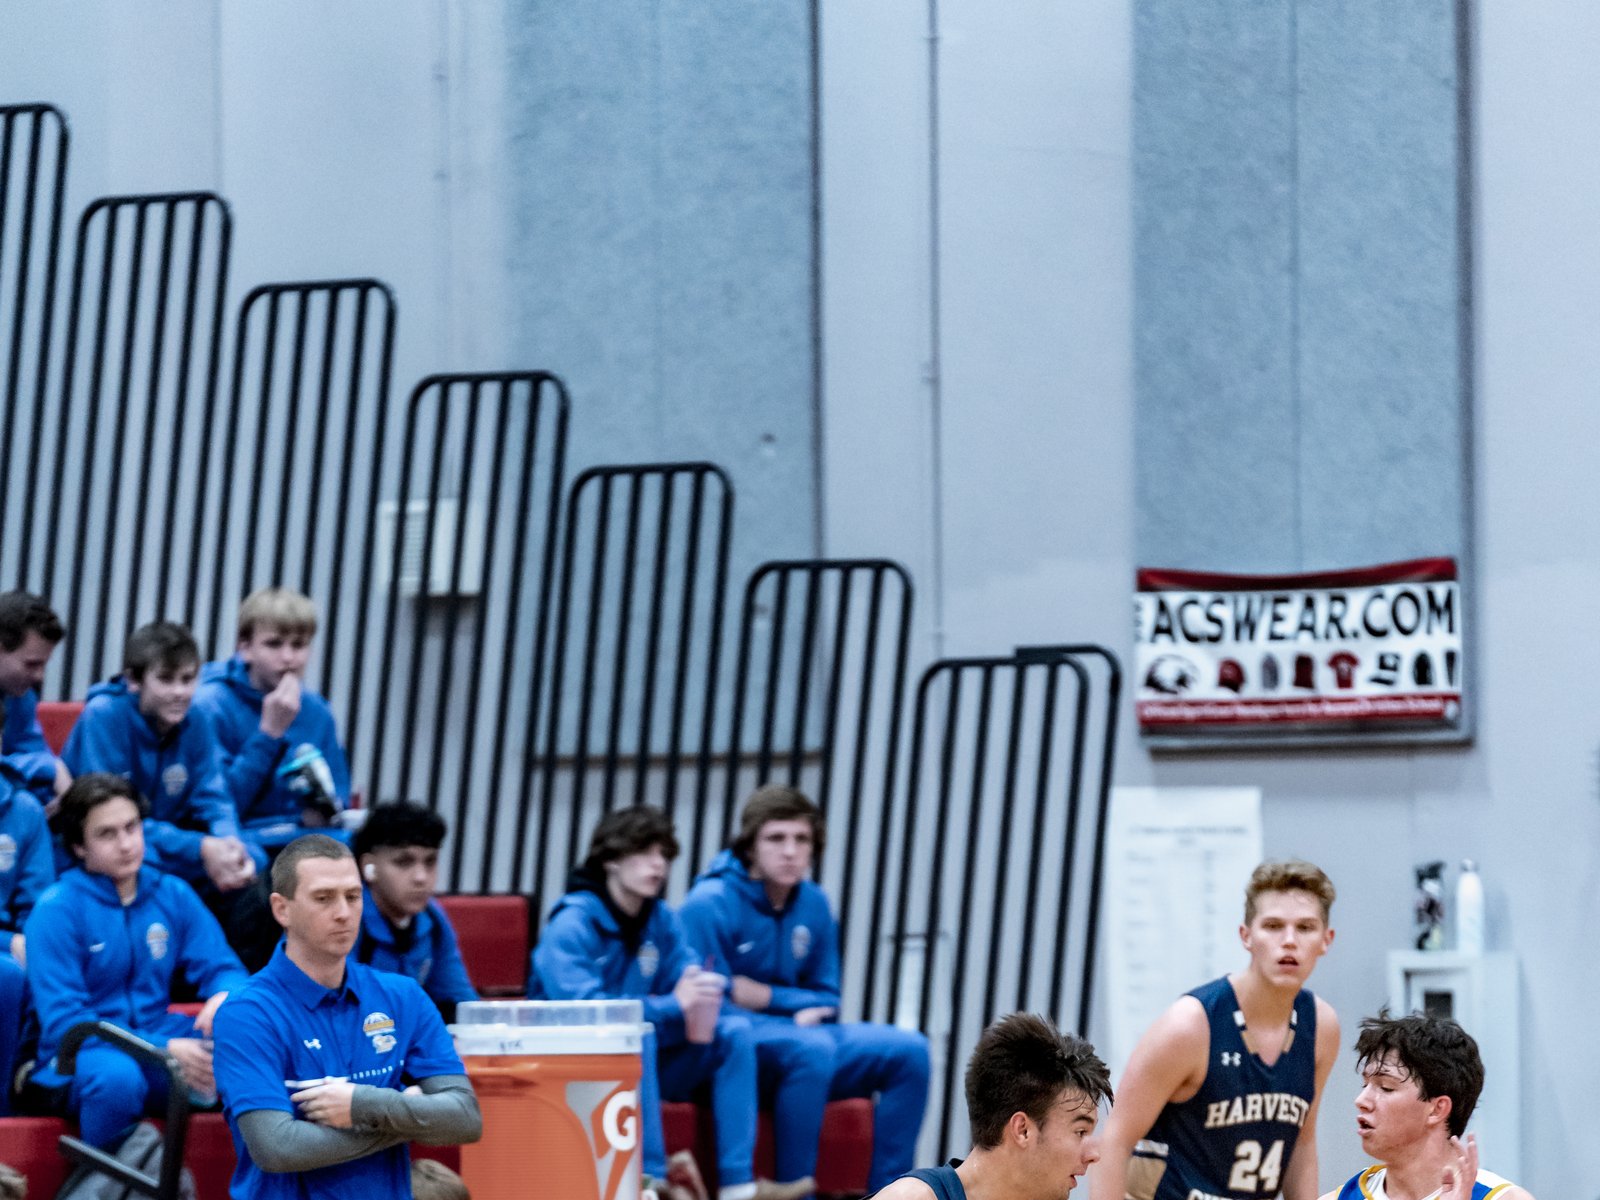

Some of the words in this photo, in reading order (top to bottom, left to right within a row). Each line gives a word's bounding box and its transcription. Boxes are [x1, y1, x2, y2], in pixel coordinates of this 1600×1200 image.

[1149, 587, 1455, 644] ACSWEAR.COM
[602, 1090, 637, 1151] G
[1204, 1092, 1309, 1129] HARVEST
[1229, 1139, 1286, 1193] 24
